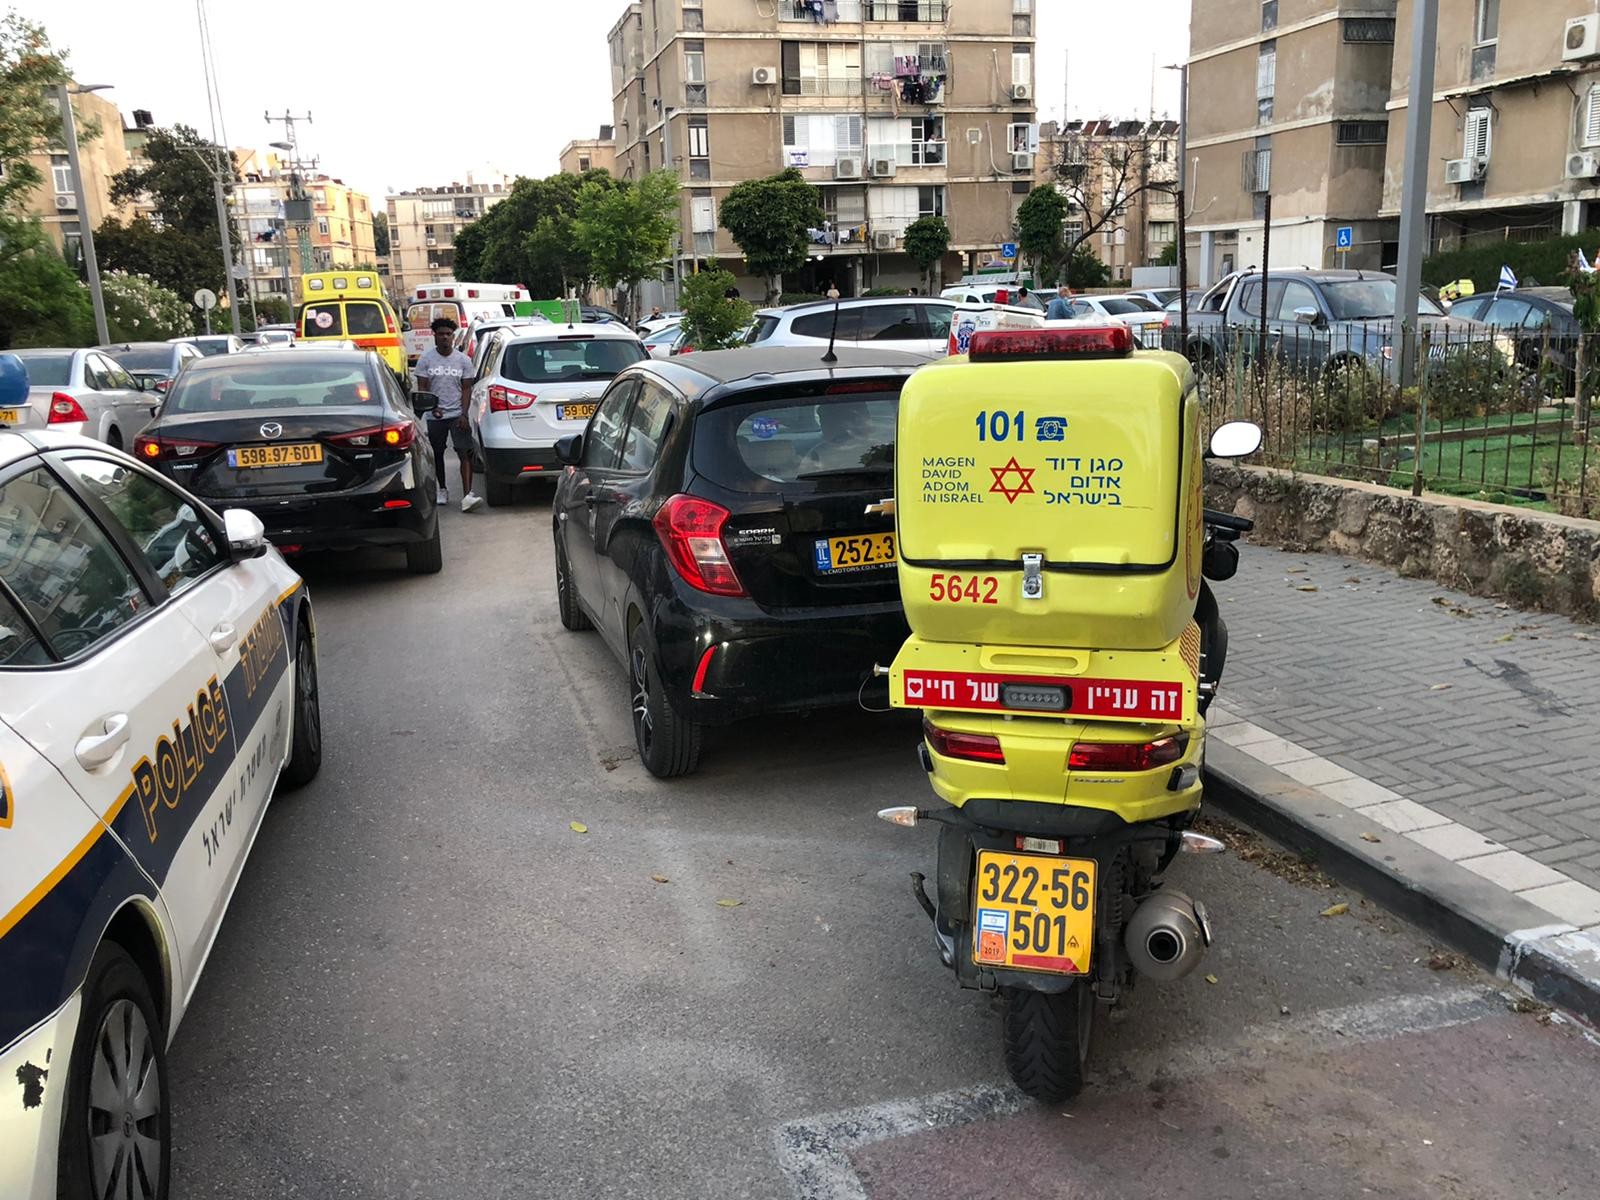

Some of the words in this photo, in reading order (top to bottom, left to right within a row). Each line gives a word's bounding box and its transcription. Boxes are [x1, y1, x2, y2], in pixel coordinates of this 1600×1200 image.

[427, 365, 464, 377] adidas
[753, 423, 777, 431] NASA
[976, 410, 1024, 442] 101
[922, 457, 975, 467] MAGEN
[1045, 457, 1080, 471] דוד
[1090, 458, 1124, 472] מגן
[922, 469, 962, 479] DAVID
[923, 481, 969, 491] ADOM
[1071, 475, 1121, 489] אדום
[923, 493, 937, 504] IN
[939, 493, 984, 504] ISRAEL
[1043, 489, 1122, 506] בישראל
[929, 573, 999, 605] 5642
[966, 678, 999, 702] של
[1087, 685, 1139, 710] עניין
[1150, 689, 1178, 712] זה
[131, 673, 228, 844] POLICE
[202, 788, 237, 867] ישראל
[1012, 910, 1066, 956] 501
